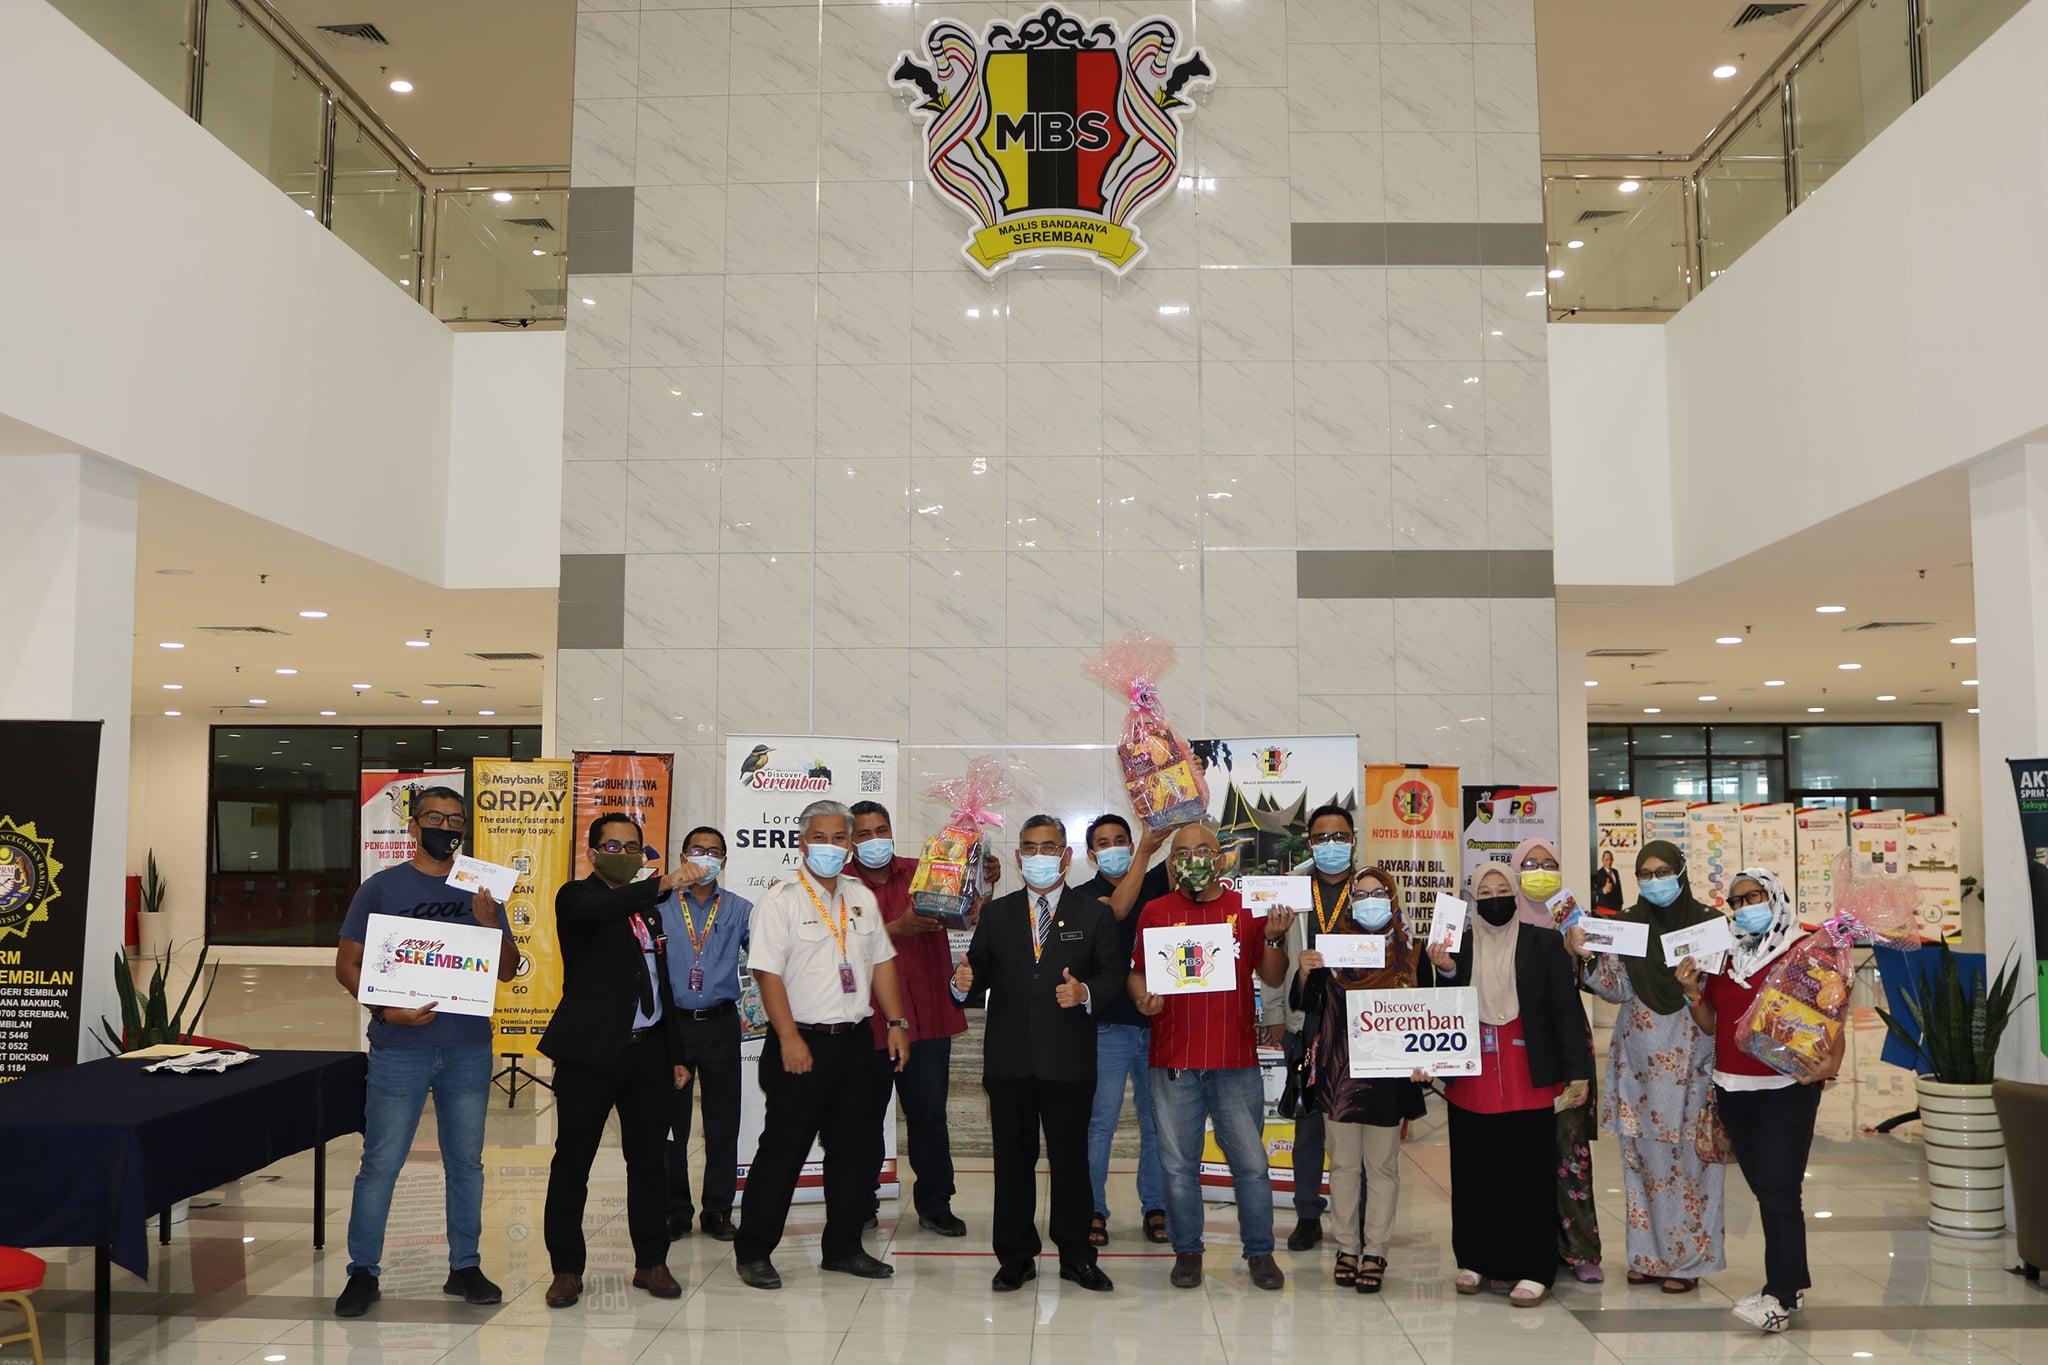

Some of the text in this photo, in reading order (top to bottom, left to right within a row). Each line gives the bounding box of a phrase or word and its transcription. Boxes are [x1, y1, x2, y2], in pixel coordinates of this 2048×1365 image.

[995, 110, 1111, 152] MBS
[999, 220, 1108, 236] MAJLIS BANDARAYA
[1013, 231, 1094, 245] SEREMBAN
[492, 775, 544, 786] Maybank
[593, 779, 657, 790] SURUHANJAYA
[752, 771, 828, 790] Seremban
[2021, 789, 2045, 798] SPRM
[477, 790, 566, 812] QRPAY
[594, 795, 629, 806] PILIHAN
[480, 816, 565, 826] The easier, faster and
[488, 826, 555, 837] safer way to pay.
[1372, 829, 1454, 840] NOTIS MAKLUMAN
[364, 842, 416, 850] PENGAUDITAN
[1378, 860, 1445, 872] BAYARAN BIL
[35, 862, 46, 899] RASUAH
[1823, 869, 1831, 881] 5
[747, 876, 766, 888] Tak
[1402, 875, 1454, 888] TAKSIRAN
[513, 886, 535, 894] CAN
[1405, 891, 1416, 903] DI
[1408, 906, 1433, 919] UNTE
[398, 938, 445, 952] PESONA
[513, 936, 531, 944] PAY
[394, 949, 490, 973] SEREMBAN
[1179, 957, 1201, 966] MBS
[24, 988, 68, 996] SEMBILAN
[512, 986, 528, 994] GO
[21, 999, 62, 1008] MAKMUR,
[1374, 1000, 1426, 1013] Discover
[18, 1010, 69, 1019] SEREMBAN,
[1360, 1010, 1465, 1032] Seremban
[9, 1032, 29, 1040] 5446
[1404, 1032, 1468, 1053] 2020
[9, 1053, 49, 1062] DICKSON
[7, 1064, 26, 1072] 1184
